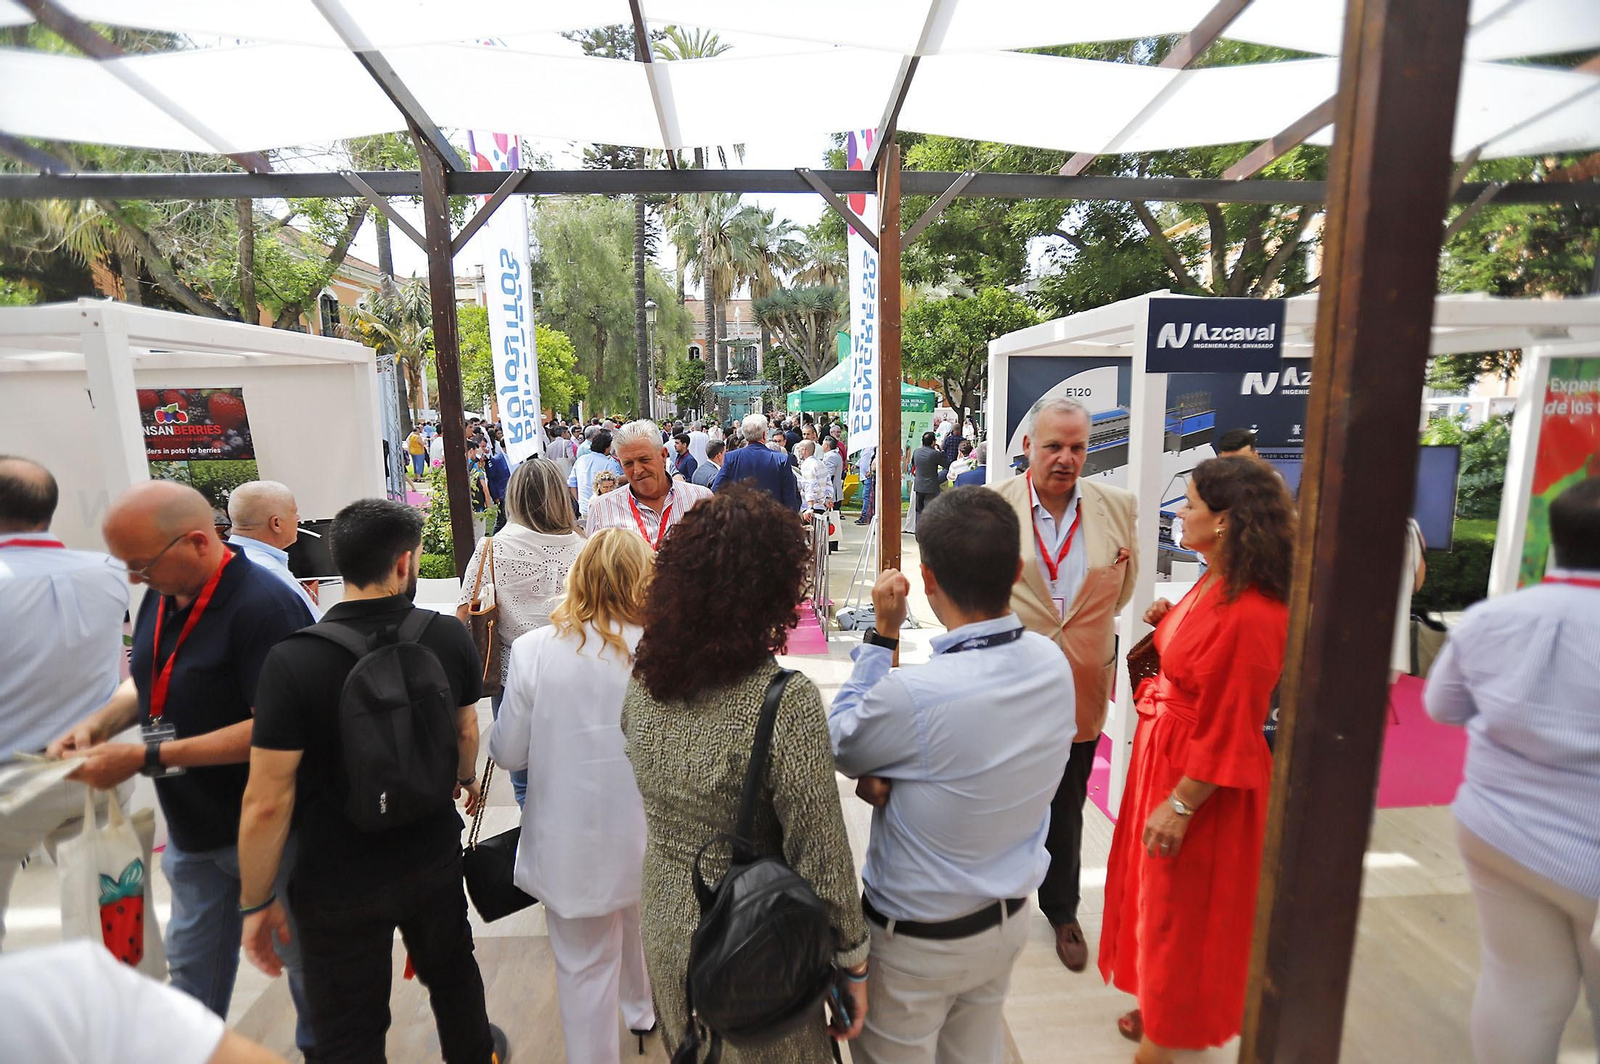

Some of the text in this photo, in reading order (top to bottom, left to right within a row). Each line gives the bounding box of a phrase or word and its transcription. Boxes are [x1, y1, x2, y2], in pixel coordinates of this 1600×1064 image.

[1193, 322, 1276, 341] Azcaval
[1066, 387, 1092, 397] E120
[1544, 399, 1593, 415] de los
[171, 447, 186, 455] pots
[198, 446, 221, 455] berries
